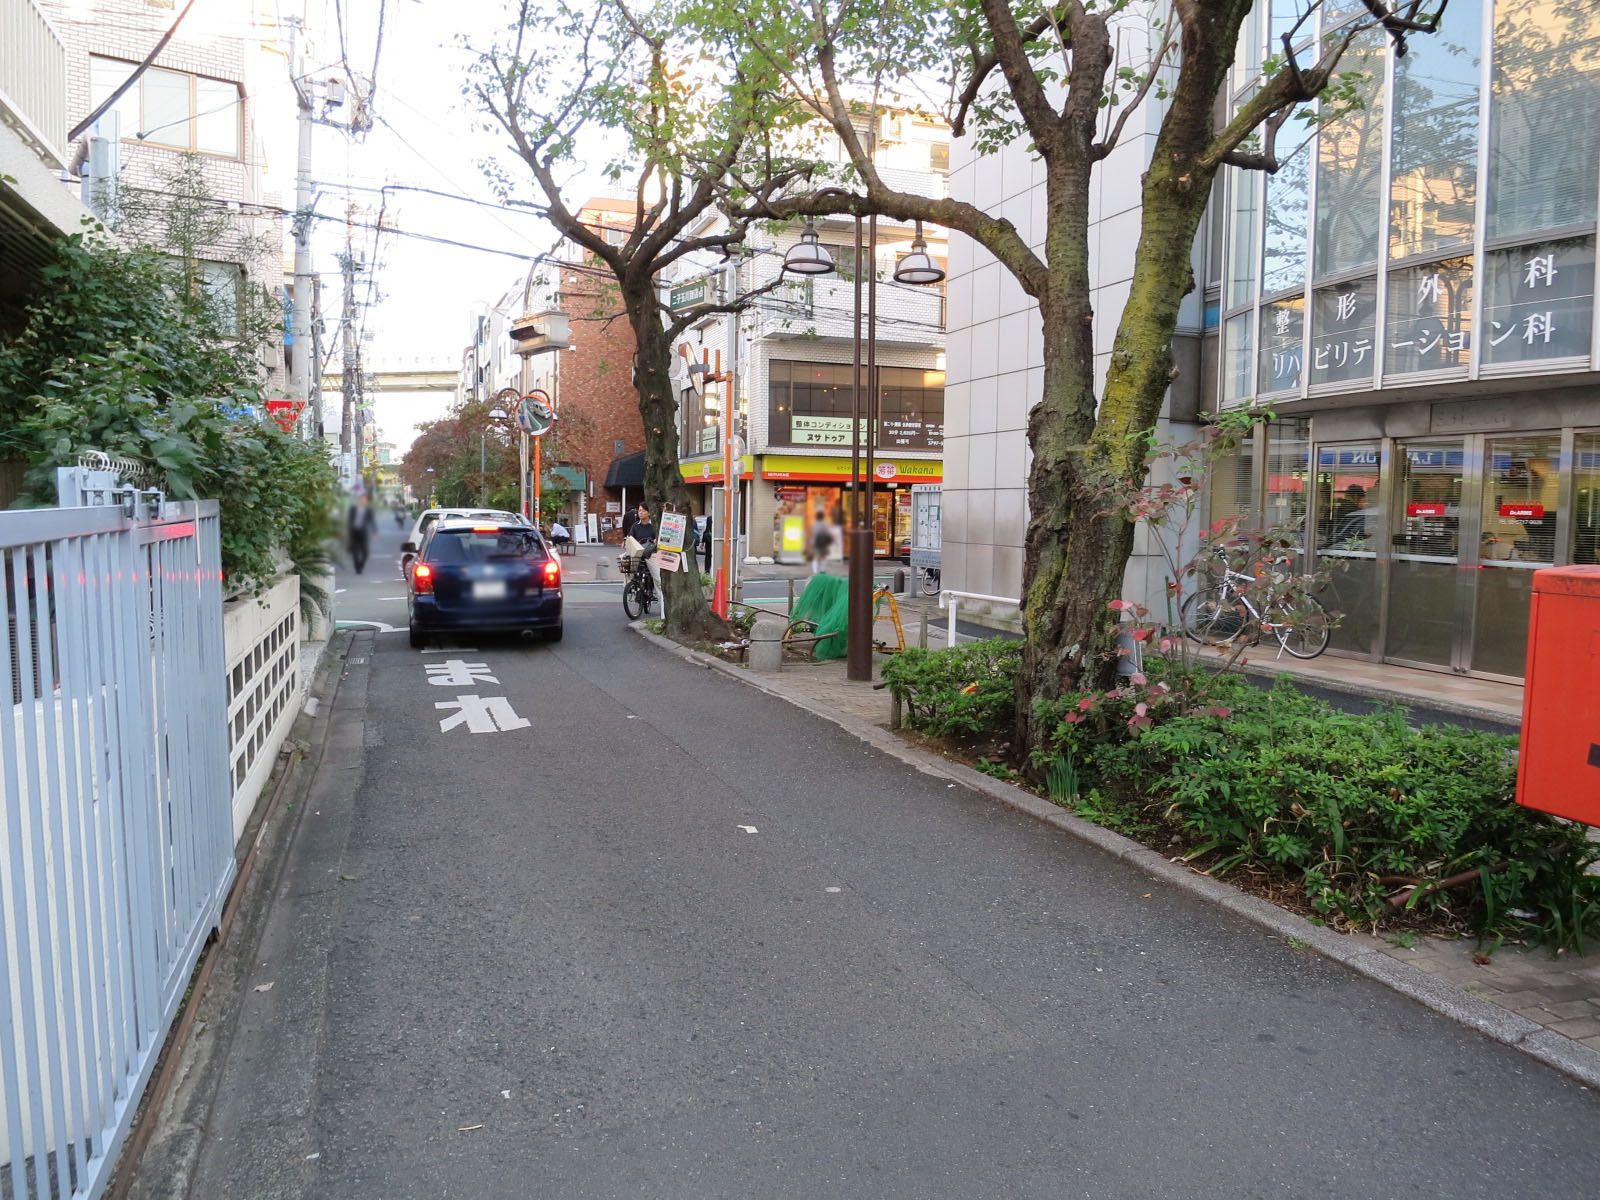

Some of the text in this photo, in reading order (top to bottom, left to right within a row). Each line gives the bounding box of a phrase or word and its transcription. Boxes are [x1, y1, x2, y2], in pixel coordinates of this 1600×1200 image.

[1274, 253, 1558, 336] 整形外科
[1271, 311, 1557, 381] リハビリテーション科
[900, 465, 934, 475] Wakana
[421, 648, 532, 734] まれ
